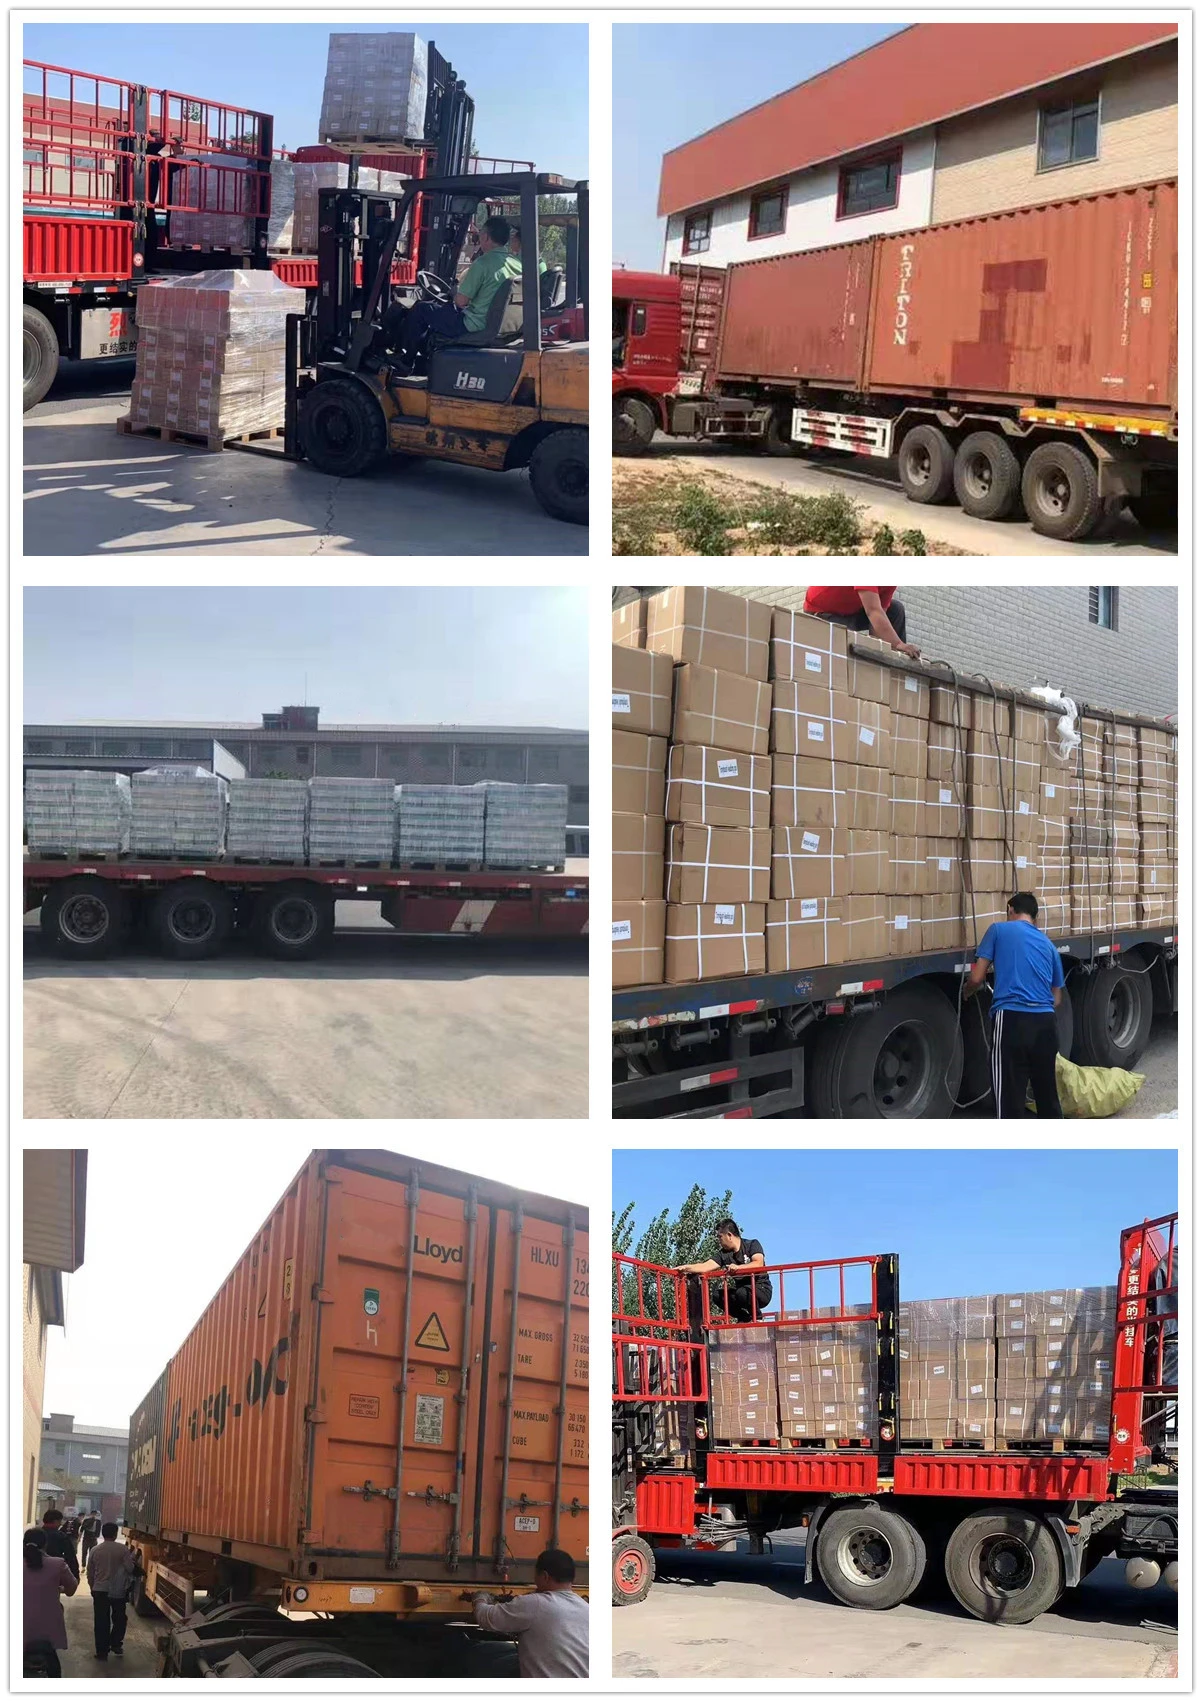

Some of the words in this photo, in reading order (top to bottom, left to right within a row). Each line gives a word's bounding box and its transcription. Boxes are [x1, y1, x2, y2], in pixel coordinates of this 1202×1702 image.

[893, 244, 915, 345] TRITON
[413, 1234, 464, 1264] Lloyd
[530, 1246, 559, 1268] HLXU
[534, 1330, 553, 1343] GROSS
[517, 1353, 533, 1365] TARE
[512, 1436, 527, 1446] CUBE
